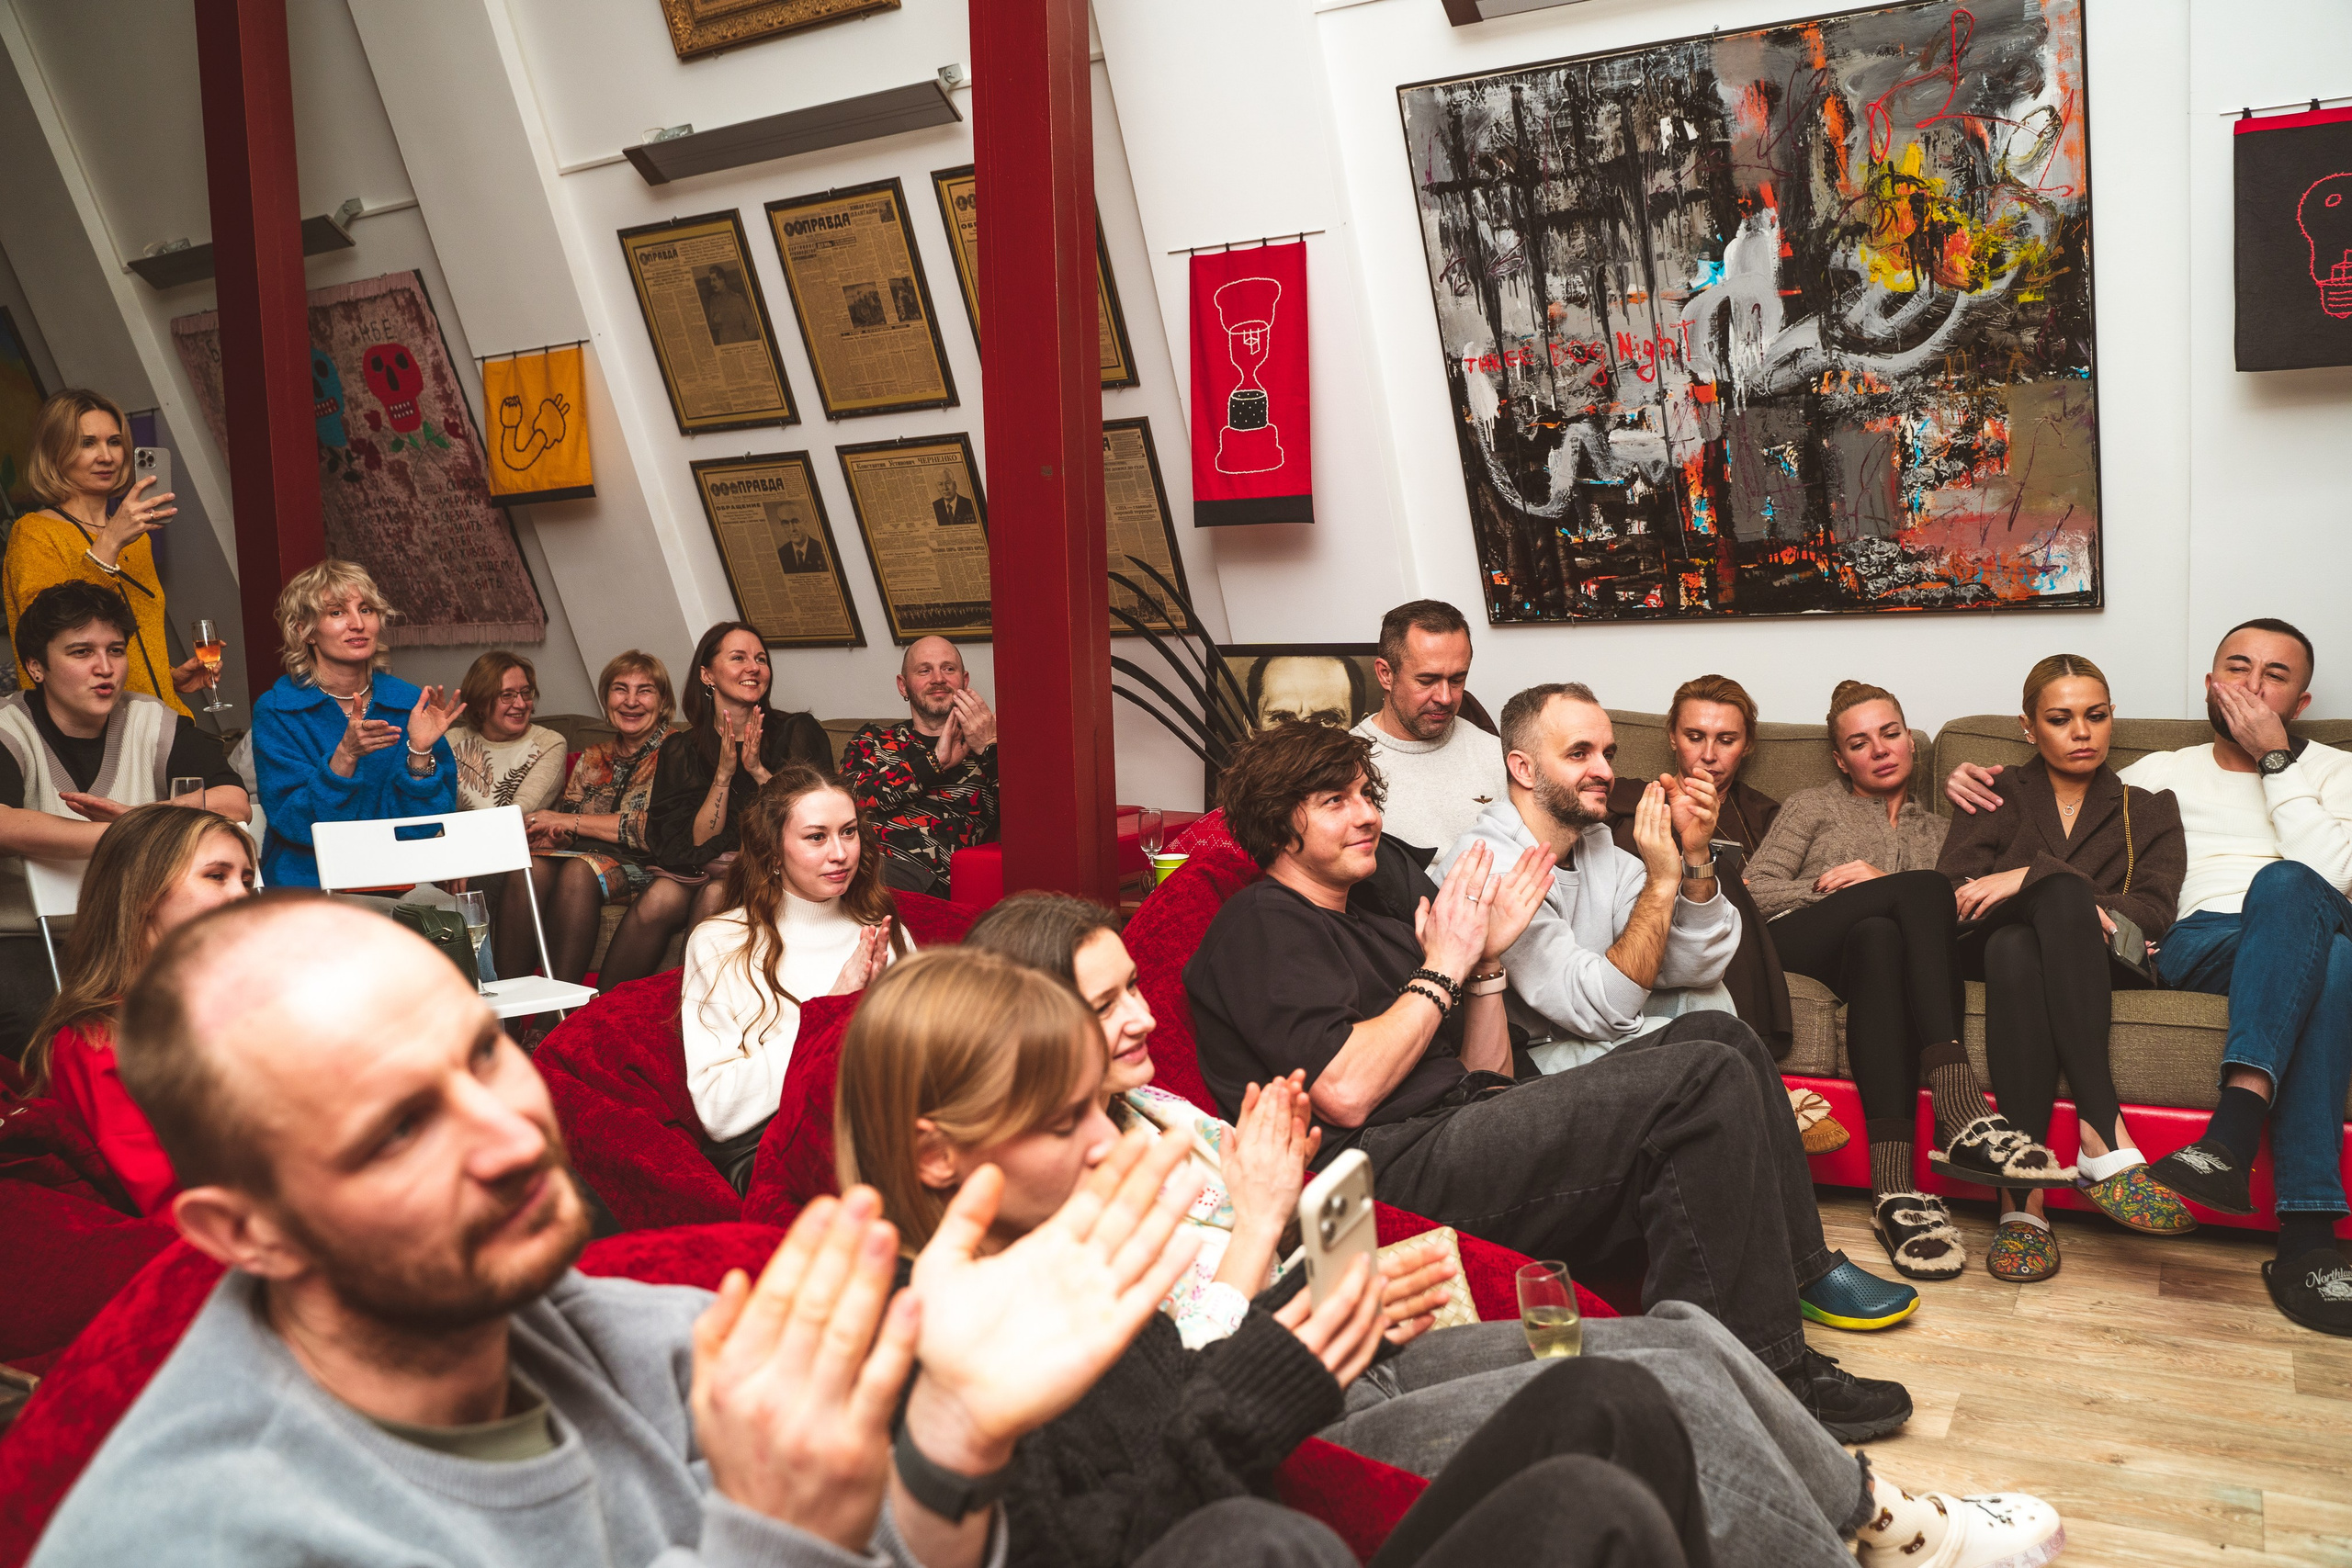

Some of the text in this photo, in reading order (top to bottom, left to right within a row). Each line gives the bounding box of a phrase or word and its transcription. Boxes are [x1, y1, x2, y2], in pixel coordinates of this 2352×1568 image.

[801, 212, 852, 234] ПРАВДА
[647, 249, 679, 263] ПРАВДА
[1463, 345, 1534, 374] THREE
[917, 455, 957, 464] ЧЕРНЕНКО
[737, 478, 786, 494] ПРАВДА
[434, 494, 481, 510] ИЗМЕРИТЬ
[716, 502, 762, 511] ОБРАЩЕНИЕ
[438, 551, 454, 563] КАК
[2305, 1268, 2352, 1288] Northlan
